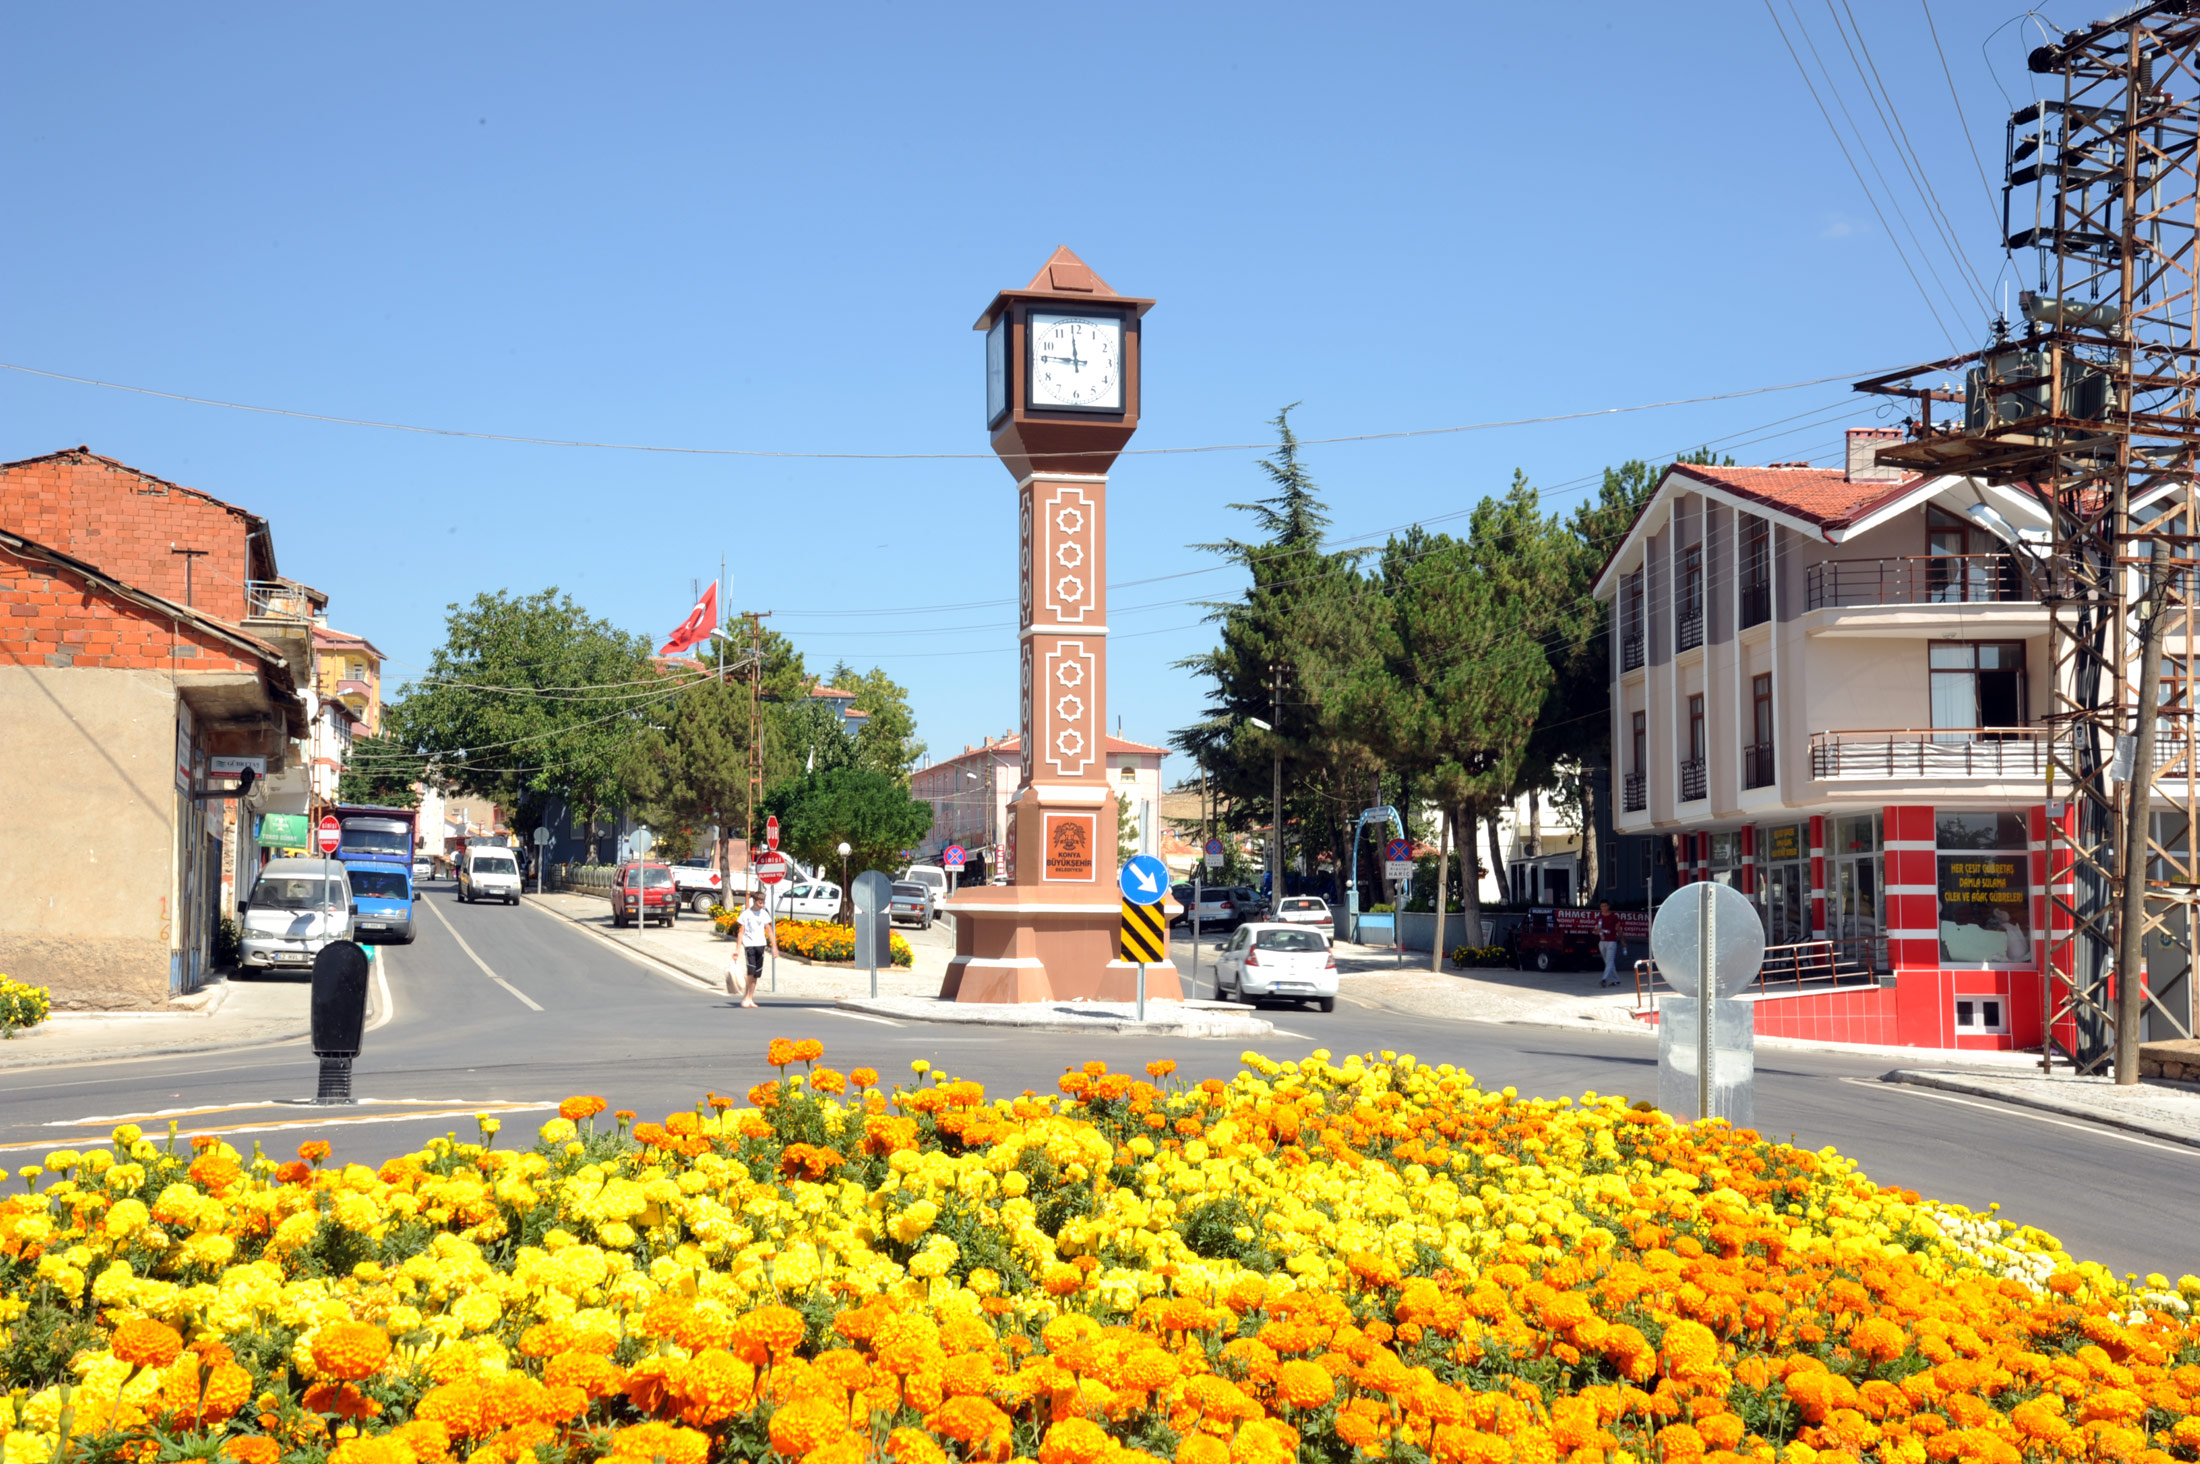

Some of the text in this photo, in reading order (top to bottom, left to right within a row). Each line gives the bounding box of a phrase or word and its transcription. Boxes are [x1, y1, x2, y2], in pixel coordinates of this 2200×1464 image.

[1055, 328, 1064, 339] 11
[1070, 324, 1082, 335] 12
[1043, 341, 1054, 351] 10
[1102, 343, 1108, 353] 2
[1107, 358, 1112, 369] 3
[1045, 372, 1052, 382] 8
[1101, 375, 1108, 384] 4
[1056, 384, 1062, 393] 7
[1090, 386, 1097, 395] 5
[1073, 389, 1080, 399] 6
[767, 826, 779, 840] DUR
[1950, 863, 1964, 874] HER
[1959, 877, 2007, 888] DAMLA SULAMA
[1962, 891, 1970, 901] VE
[1558, 910, 1591, 919] AHMET
